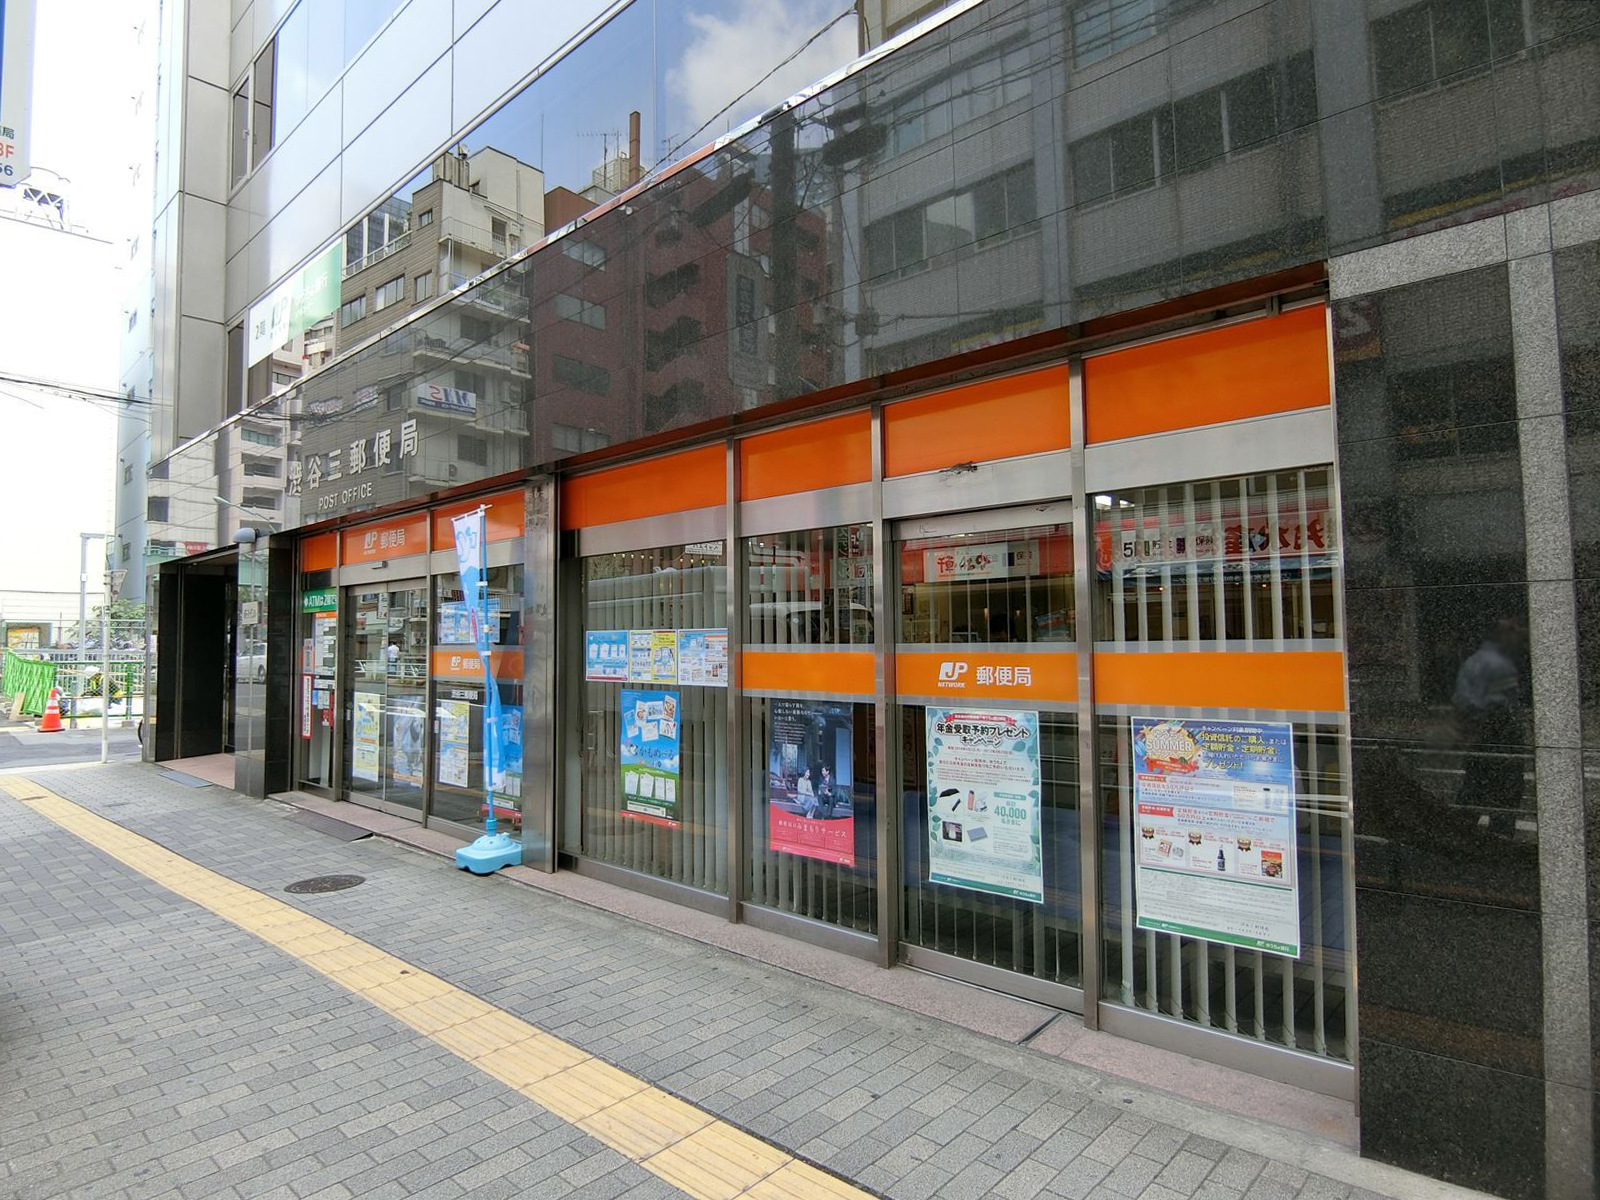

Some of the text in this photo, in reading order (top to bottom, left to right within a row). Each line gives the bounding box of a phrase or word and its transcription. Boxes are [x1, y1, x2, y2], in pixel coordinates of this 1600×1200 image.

[289, 418, 419, 497] 渋谷三郵便局
[318, 482, 373, 511] POST OFFICE
[380, 528, 405, 549] 郵便局
[939, 661, 968, 681] JP
[976, 666, 1032, 687] 郵便局
[937, 723, 1029, 739] 年金受取予約プレゼント
[962, 736, 1001, 747] キャンペーン
[1146, 739, 1192, 751] SUMMER
[994, 806, 1027, 820] 40,000
